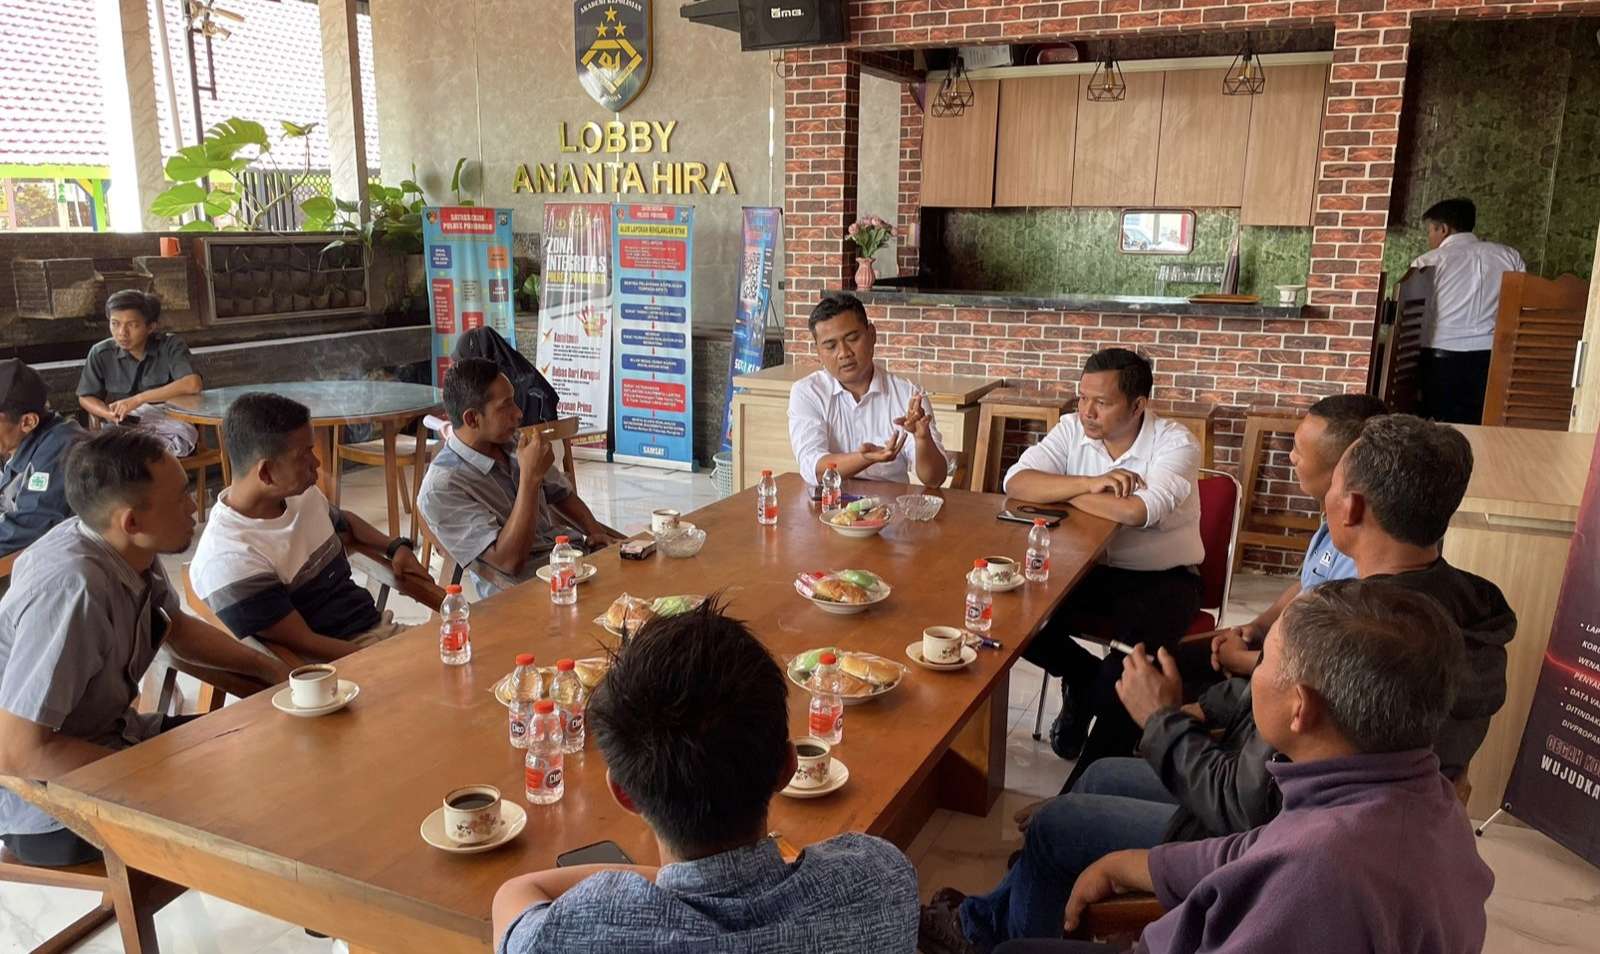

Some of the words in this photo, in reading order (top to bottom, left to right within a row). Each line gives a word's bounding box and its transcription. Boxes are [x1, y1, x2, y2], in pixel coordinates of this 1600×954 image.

[558, 120, 677, 154] LOBBY
[511, 161, 648, 194] ANANTA
[652, 161, 738, 194] HIRA
[546, 236, 574, 254] ZONA
[1578, 656, 1600, 673] WENA
[1569, 688, 1589, 703] DATA
[1565, 703, 1600, 728] DITINDAK
